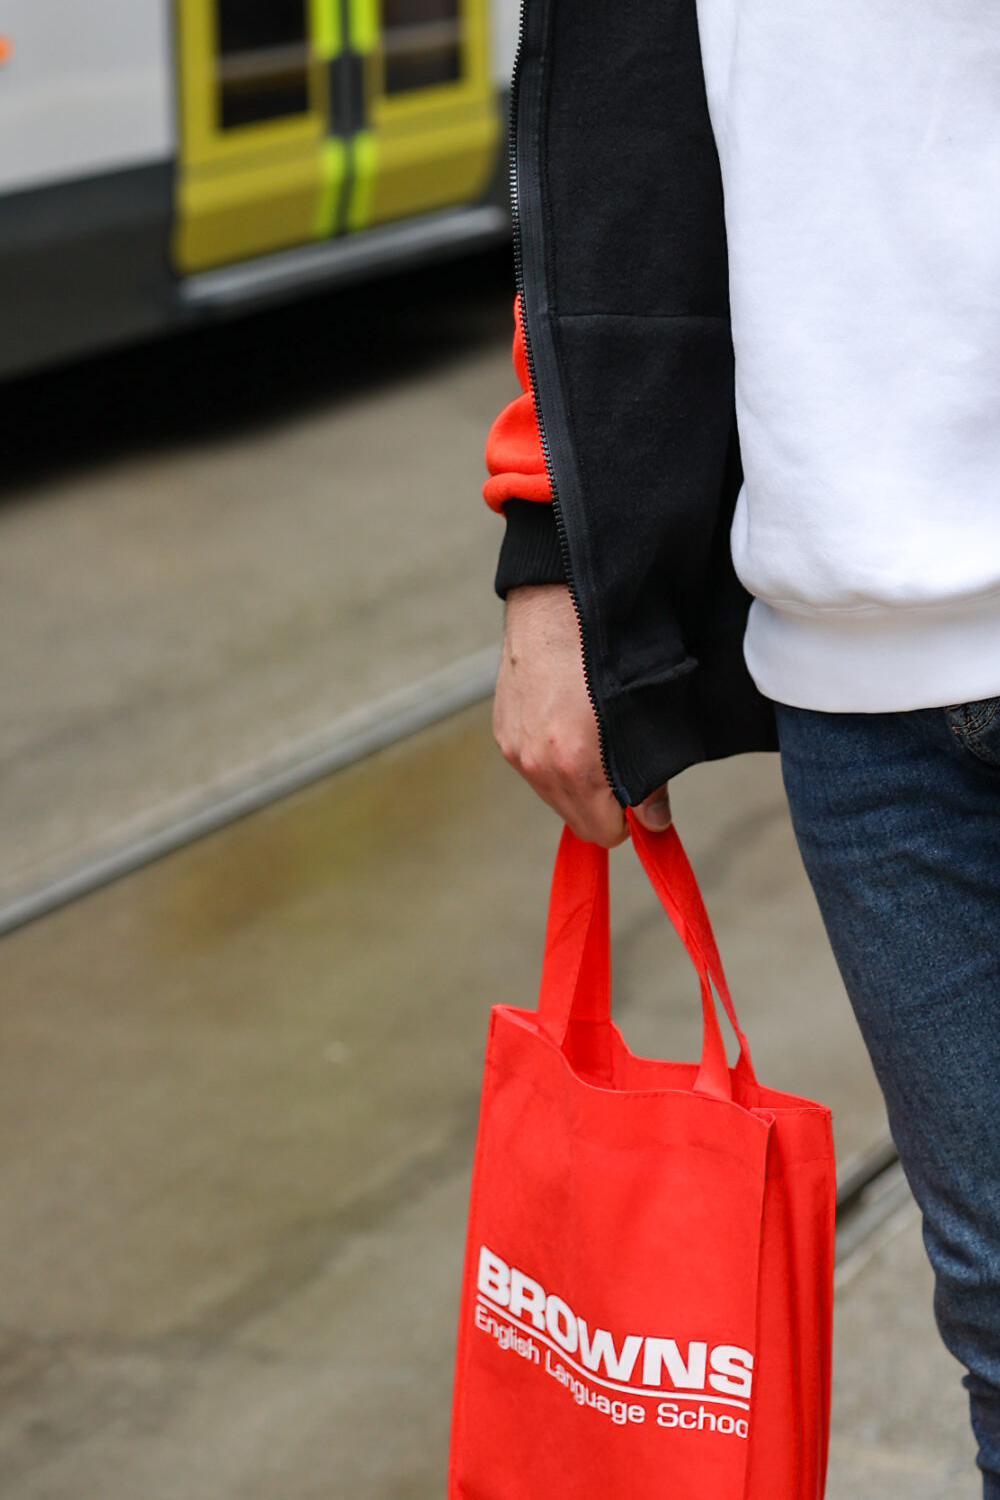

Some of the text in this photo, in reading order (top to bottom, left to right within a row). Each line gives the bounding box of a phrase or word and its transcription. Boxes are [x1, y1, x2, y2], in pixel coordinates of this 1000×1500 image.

[475, 1303, 541, 1365] English
[545, 1349, 646, 1426] Language
[477, 1244, 755, 1399] BROWNS
